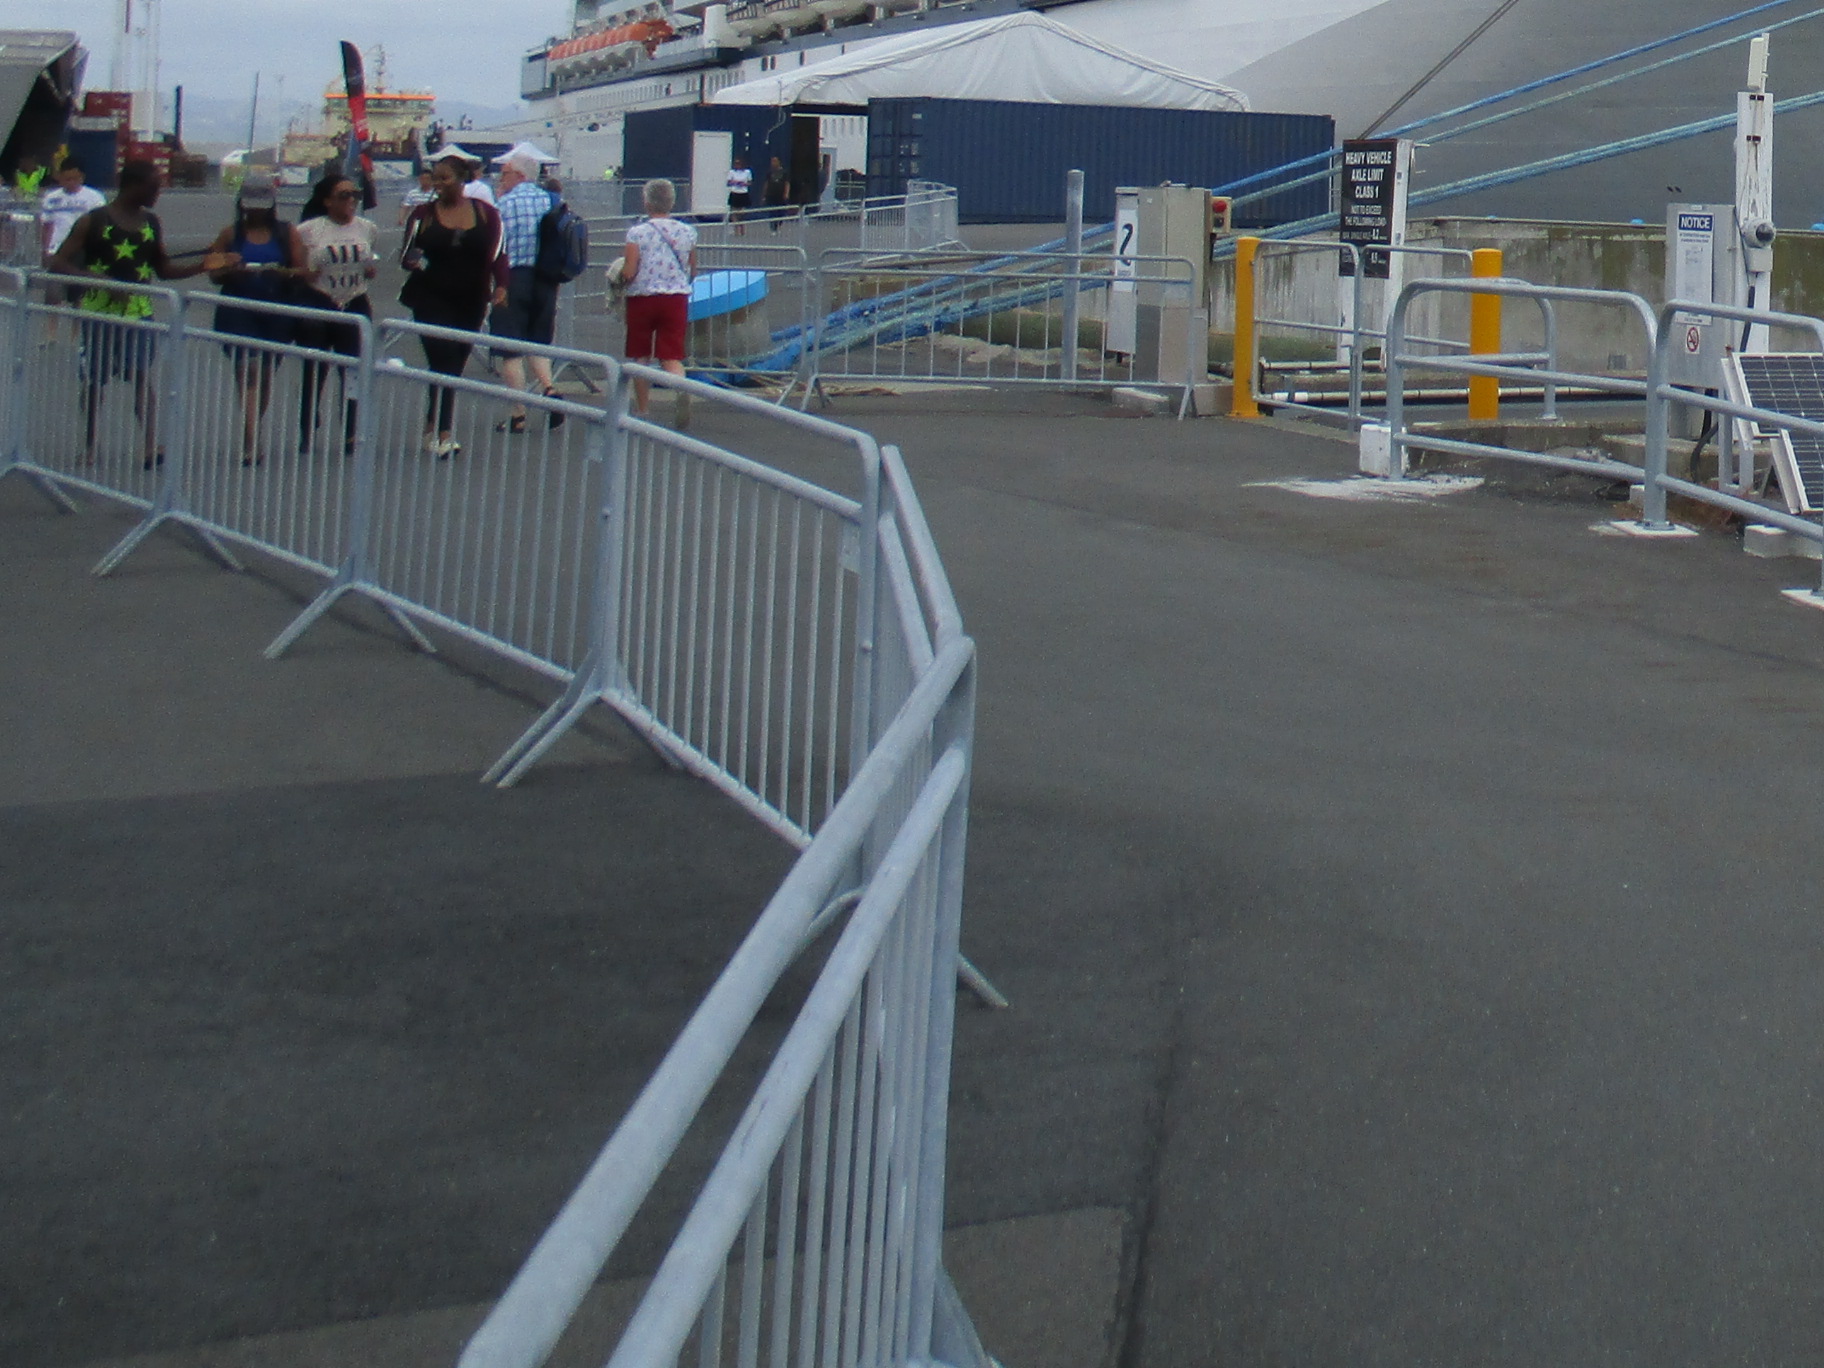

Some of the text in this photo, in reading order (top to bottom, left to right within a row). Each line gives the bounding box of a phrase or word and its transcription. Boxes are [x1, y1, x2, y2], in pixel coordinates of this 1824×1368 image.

[1345, 151, 1392, 165] HEAVY VEHICLE
[1351, 168, 1384, 182] AXLE LIMIT
[1355, 185, 1379, 199] CLASS 1
[1681, 216, 1711, 230] NOTICE
[1119, 223, 1133, 267] 2
